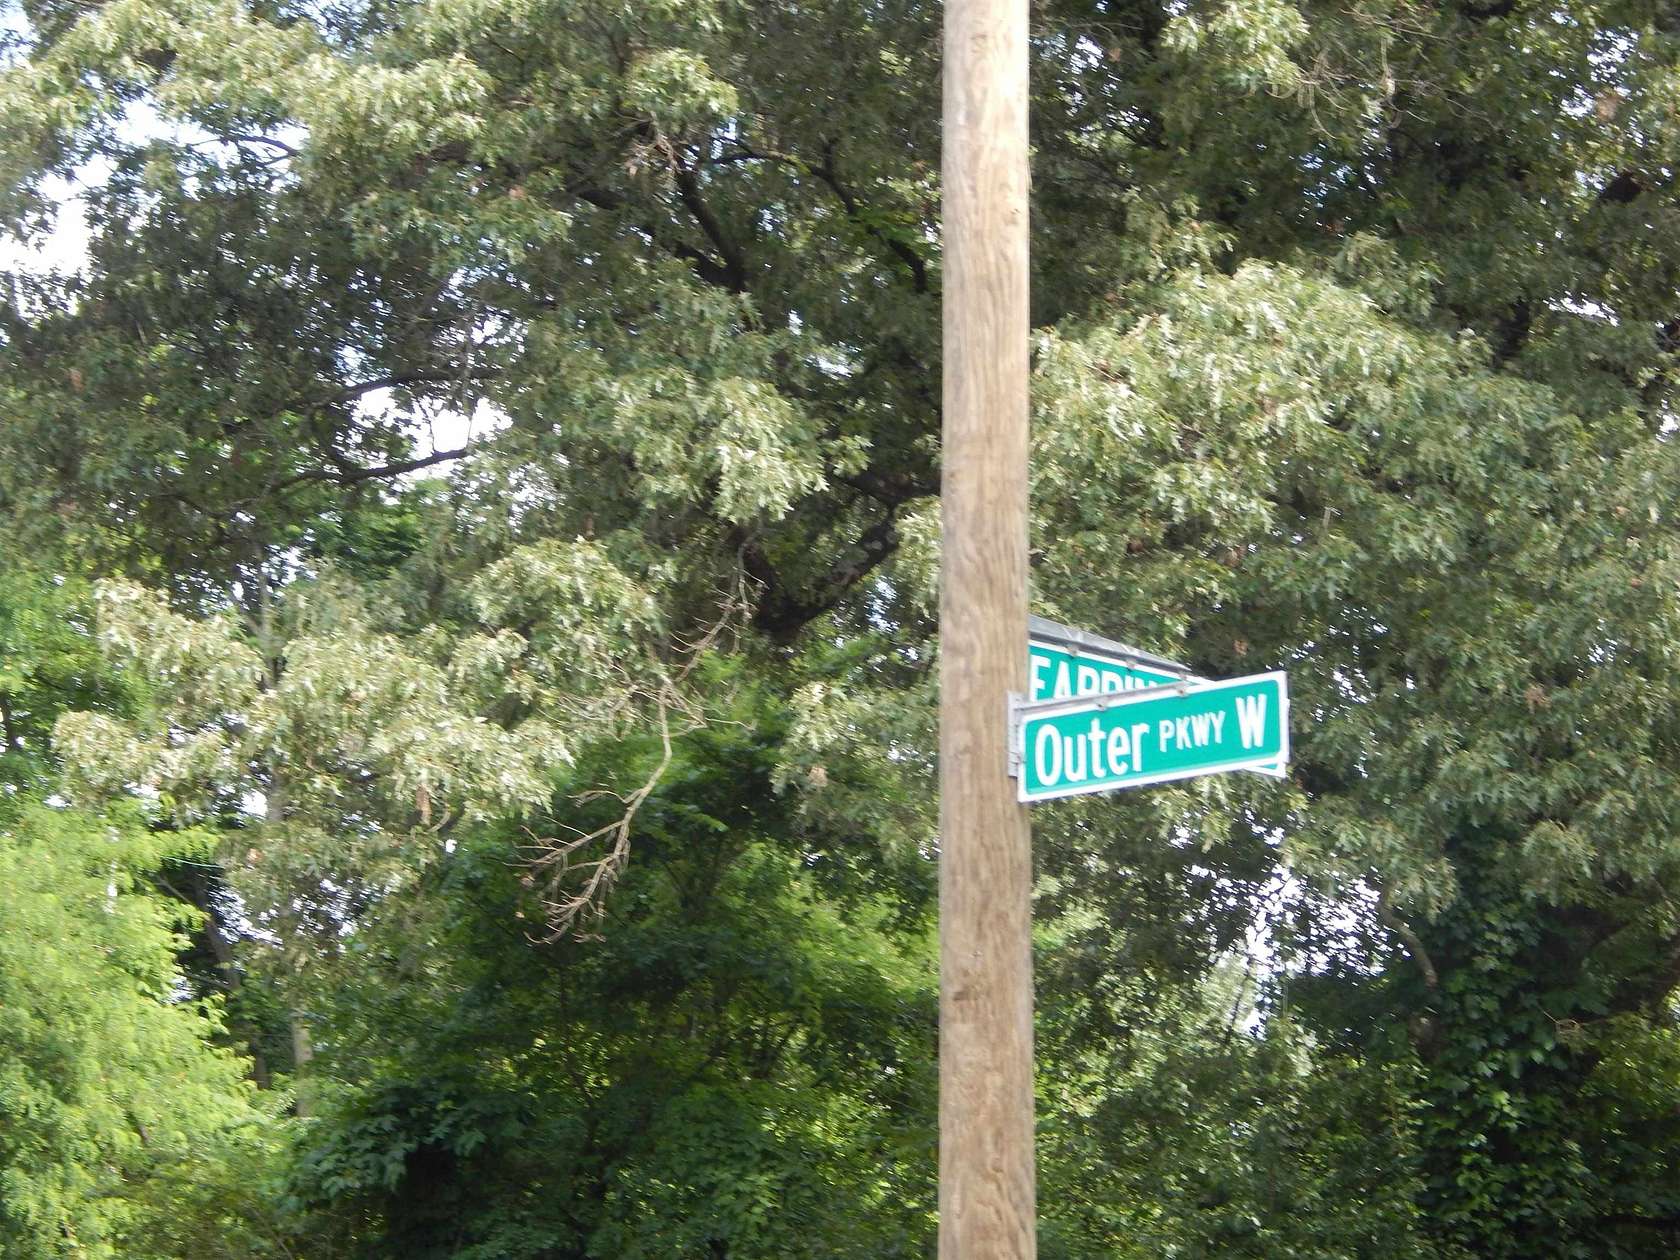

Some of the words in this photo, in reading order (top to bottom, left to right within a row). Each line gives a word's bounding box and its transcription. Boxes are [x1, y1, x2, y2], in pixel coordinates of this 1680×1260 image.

[1035, 718, 1149, 787] Outer
[1159, 709, 1226, 753] PKWY
[1235, 693, 1268, 750] W
